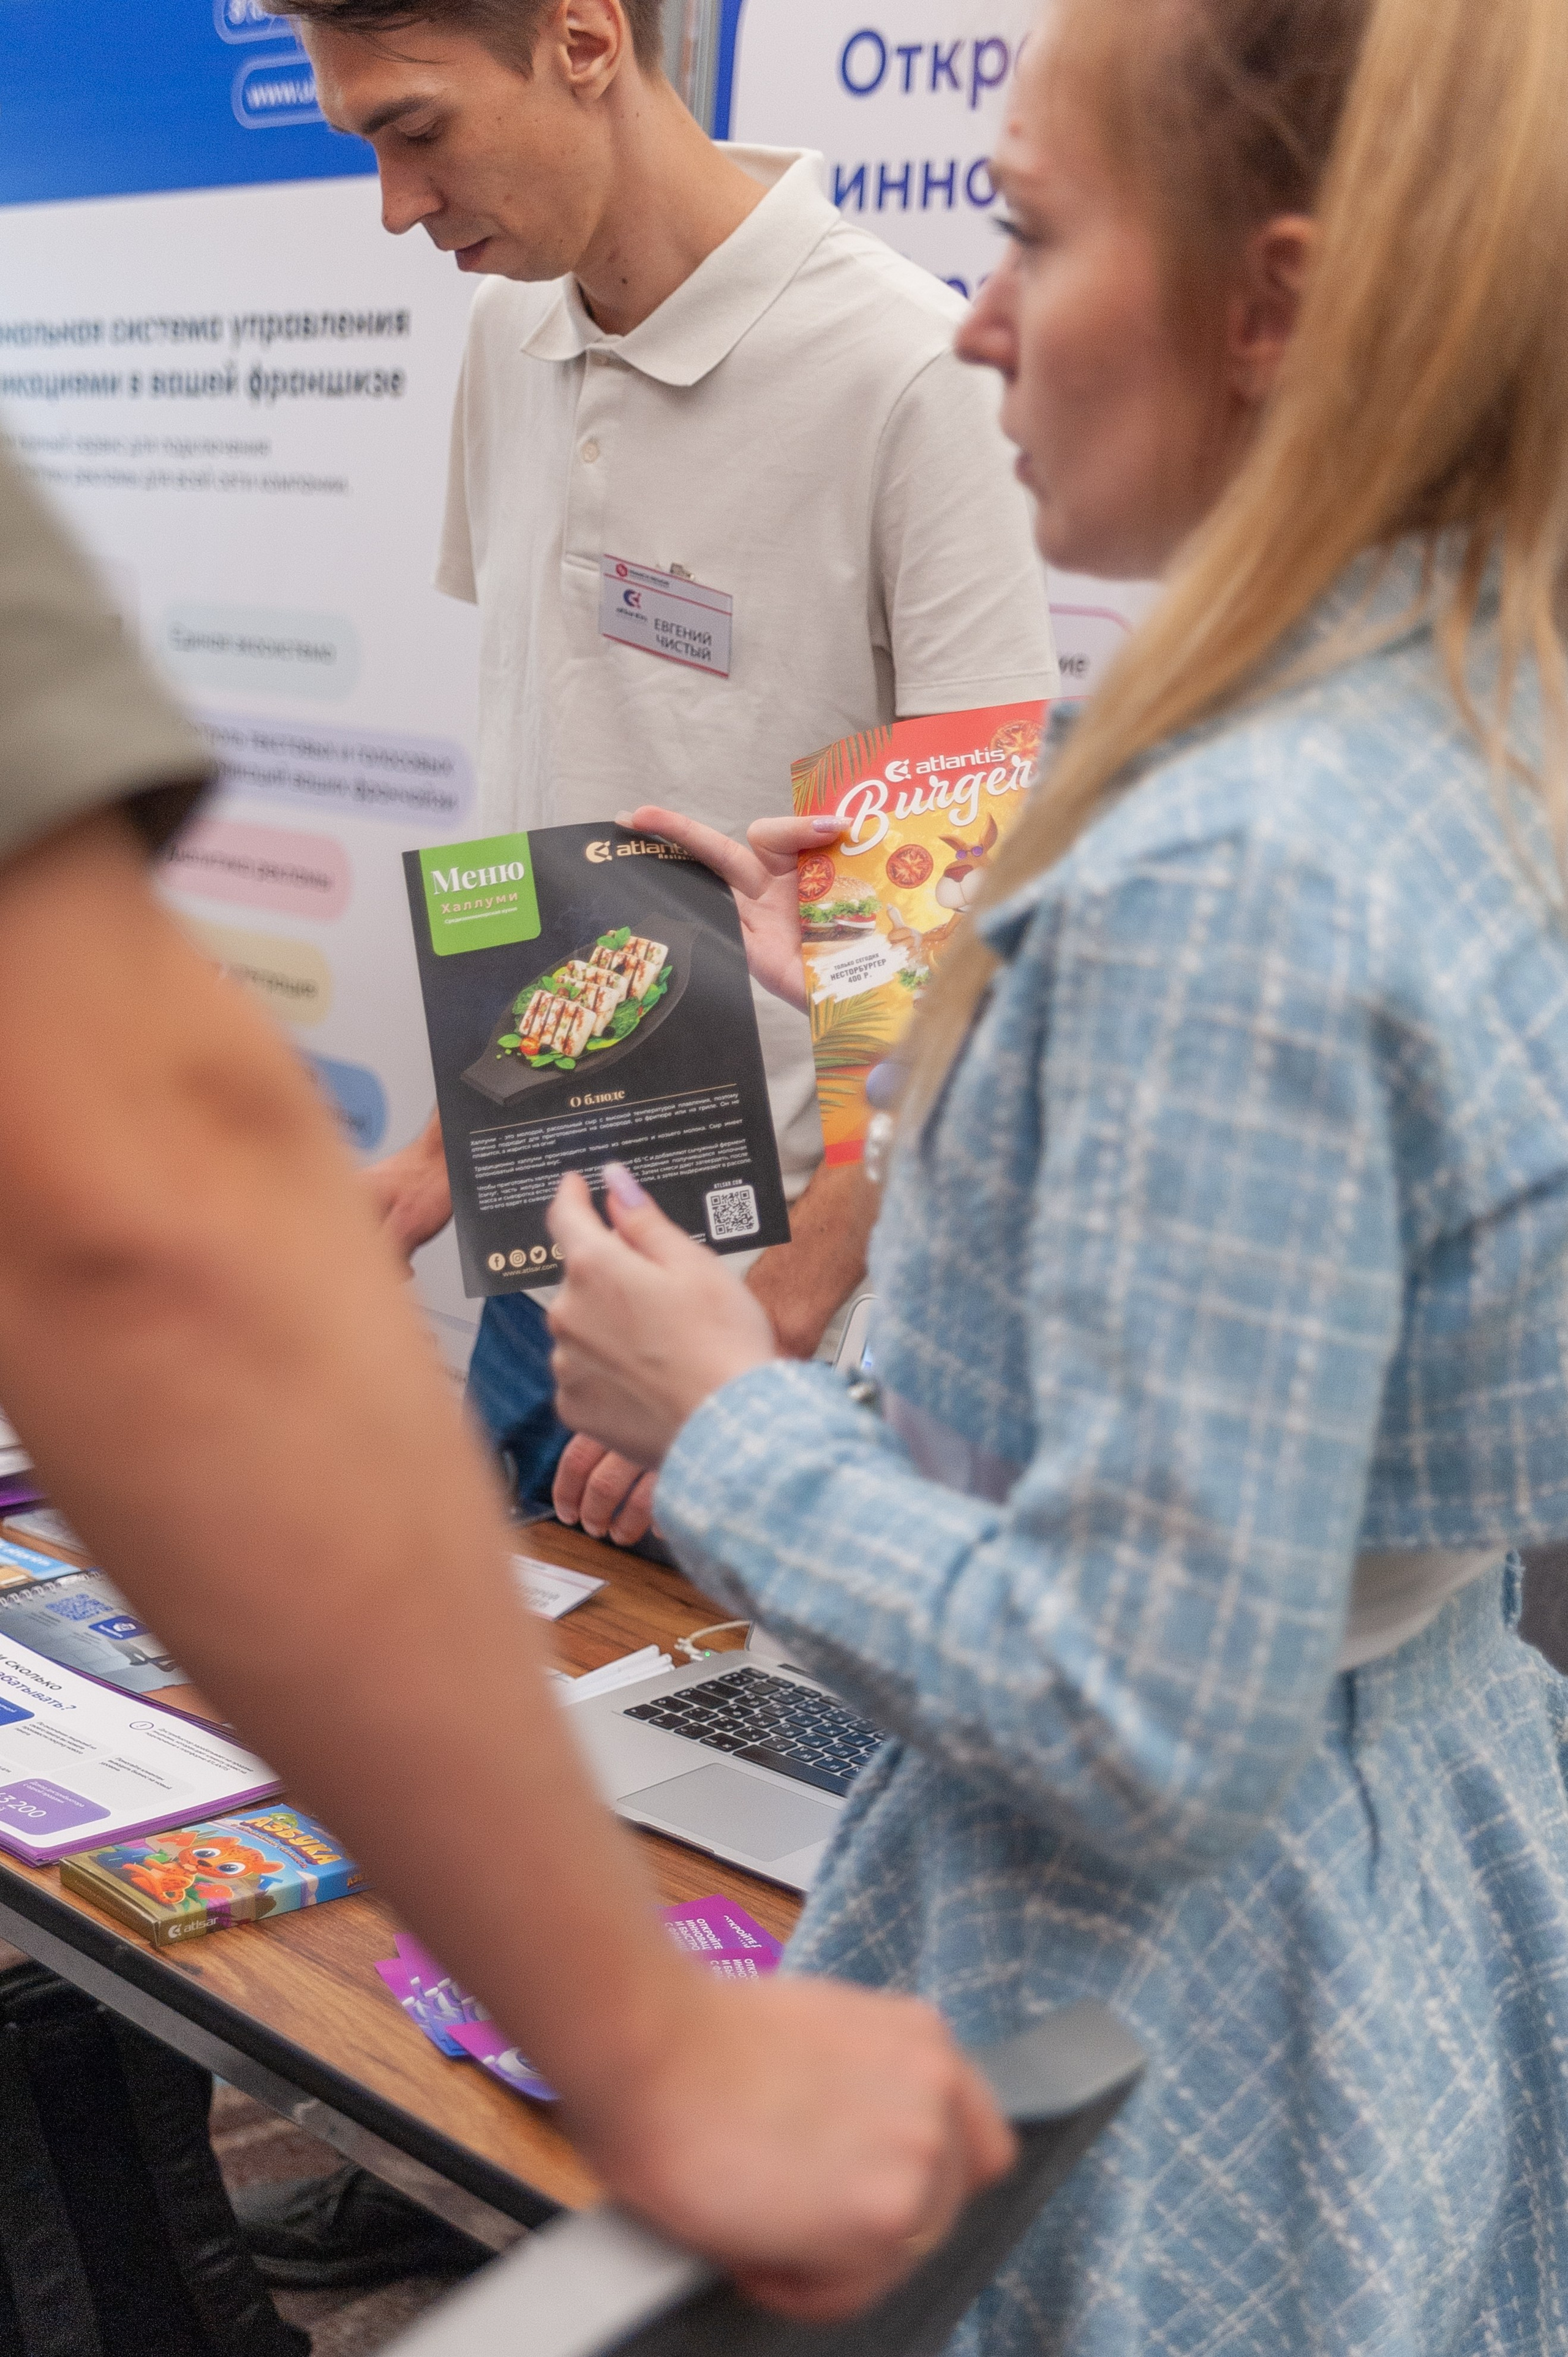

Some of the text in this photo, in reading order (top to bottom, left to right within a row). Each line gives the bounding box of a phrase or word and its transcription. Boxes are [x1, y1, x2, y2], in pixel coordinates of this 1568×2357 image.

[0, 321, 103, 347] нальная
[229, 309, 410, 349] управления
[247, 361, 404, 407] франшизе
[654, 618, 712, 646] ЕВГЕНИЙ
[655, 634, 712, 662] ЧИСТЫЙ
[916, 747, 1006, 774] atlantis
[835, 755, 1039, 856] Burger
[616, 841, 688, 857] atlant
[431, 861, 524, 895] Меню
[442, 892, 518, 914] Халлуми
[830, 958, 887, 981] НЕСТОРБУРГЕР
[834, 953, 880, 970] ТОЛЬКО СЕГОДНЯ
[848, 974, 862, 983] 400
[570, 1089, 625, 1108] О блюде
[470, 1137, 497, 1147] Халлуми
[605, 1112, 631, 1121] высокой
[633, 1104, 676, 1117] температурой
[714, 1093, 739, 1102] поэтому
[470, 1144, 496, 1152] отлично
[497, 1138, 526, 1148] подходит
[542, 1127, 587, 1140] приготовления
[644, 1111, 672, 1121] фритюре
[473, 1159, 515, 1172] Традиционно
[516, 1156, 542, 1165] халлуми
[544, 1148, 586, 1159] производится
[620, 1137, 648, 1145] овечьего
[496, 1178, 534, 1189] приготовить
[654, 1149, 687, 1160] добавляют
[719, 1138, 746, 1148] фермент
[475, 1167, 514, 1178] солоноватый
[514, 1161, 545, 1171] молочный
[527, 1194, 555, 1203] сыворот
[502, 1263, 557, 1277] www.atlsar.com
[5, 1660, 62, 1690] сколько
[203, 1759, 232, 1771] ATLANTIS
[240, 1816, 342, 1865] АЗБУКА
[184, 1917, 218, 1932] atlsar
[696, 1918, 723, 1950] ОТКРОЙТЕ
[679, 1927, 700, 1951] БЫСТРО
[725, 1965, 736, 1980] БЫС
[733, 1959, 747, 1978] ИННО
[744, 1958, 760, 1980] ОТКРО
